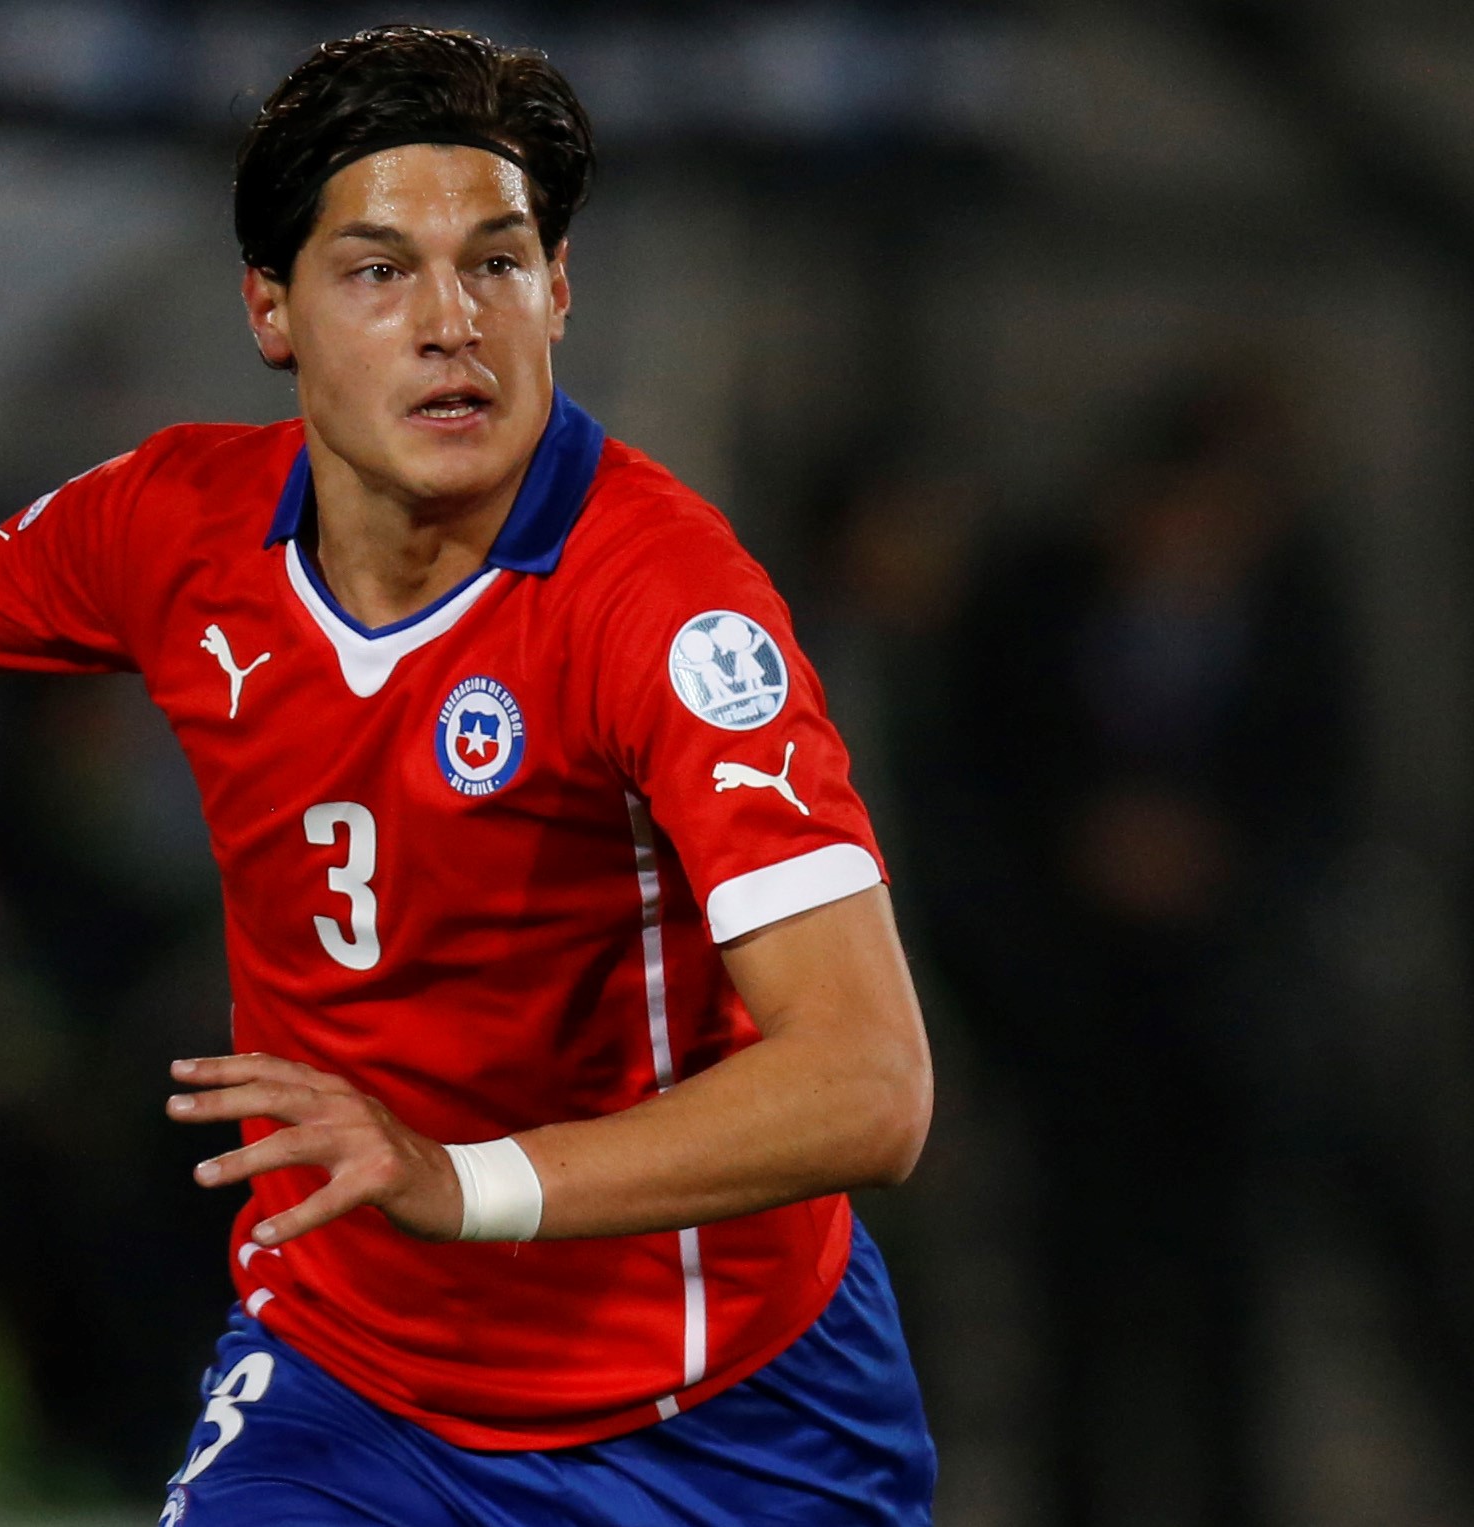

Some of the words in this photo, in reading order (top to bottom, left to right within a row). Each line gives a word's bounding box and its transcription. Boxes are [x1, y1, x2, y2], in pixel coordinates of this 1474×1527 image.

[487, 681, 502, 697] DE
[499, 692, 524, 737] FUTBOL
[450, 775, 462, 791] DE
[464, 780, 495, 795] CHILE
[303, 801, 381, 971] 3
[171, 1351, 275, 1485] 3
